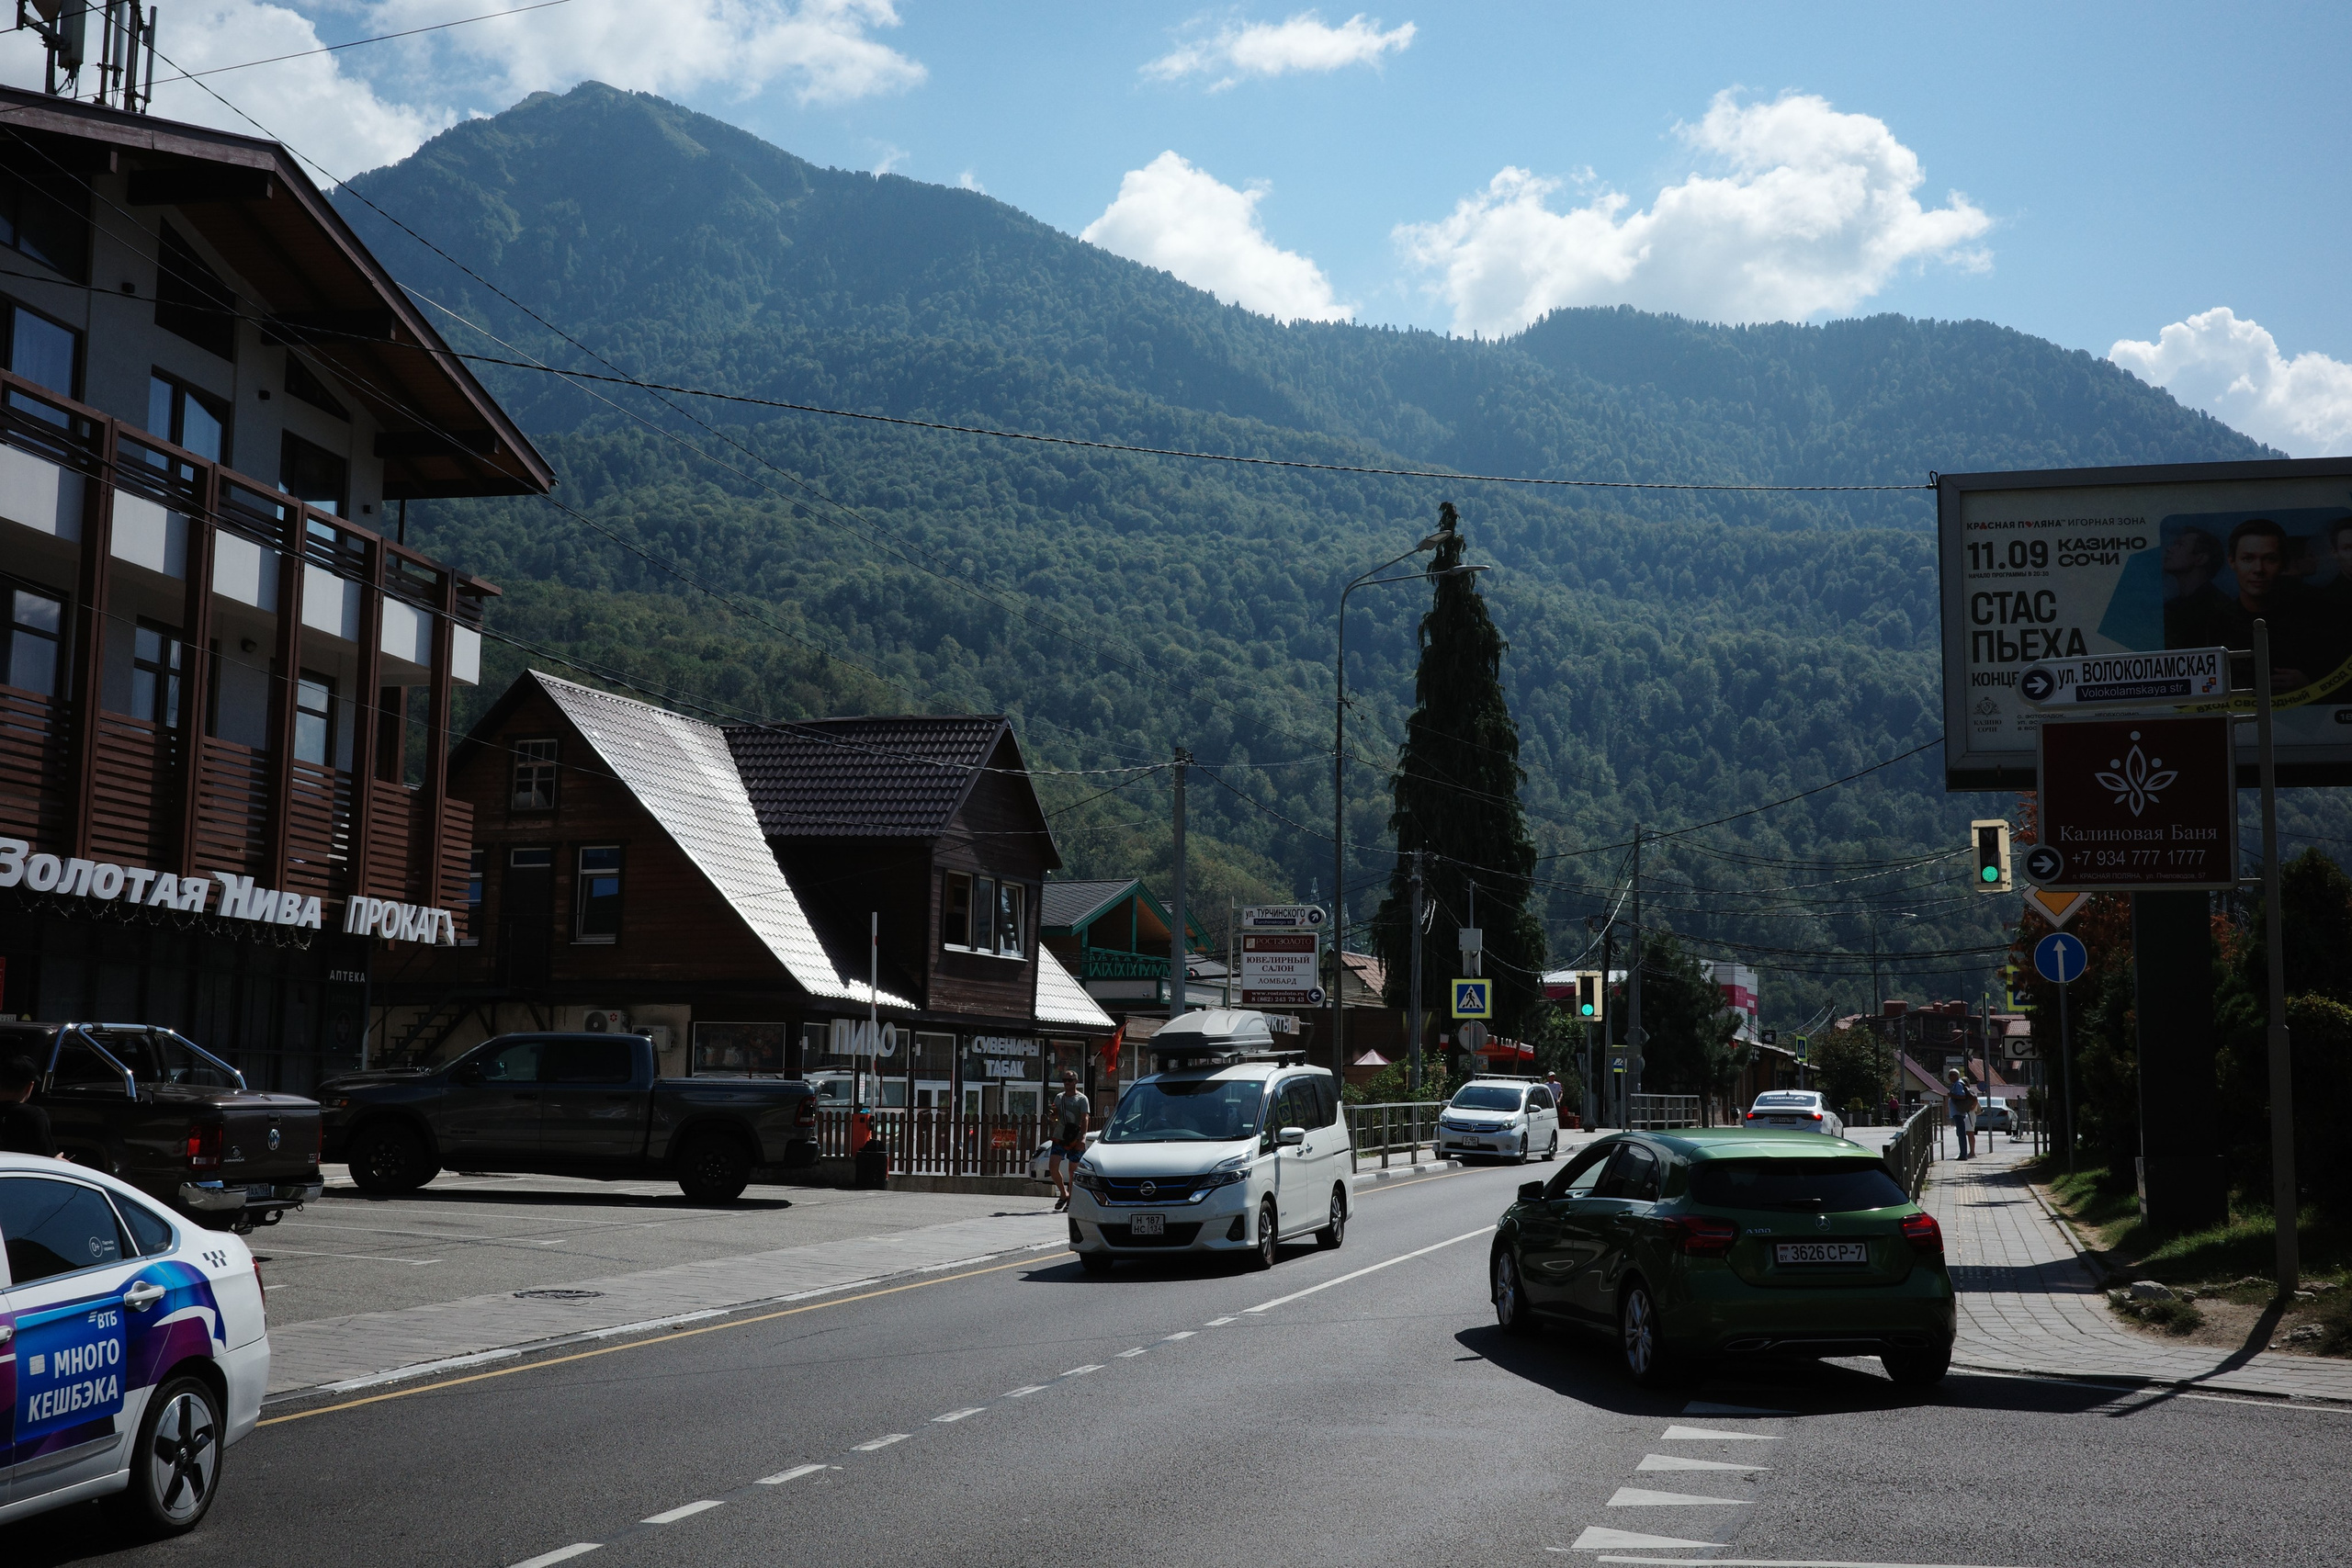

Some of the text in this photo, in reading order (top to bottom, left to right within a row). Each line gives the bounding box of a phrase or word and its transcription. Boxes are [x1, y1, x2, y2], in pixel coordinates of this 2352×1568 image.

[2068, 517, 2115, 527] ИГОРНАЯ
[2118, 516, 2146, 526] ЗОНА
[2058, 536, 2147, 552] КАЗИНО
[1967, 540, 2049, 570] 11.09
[2058, 553, 2120, 568] СОЧИ
[1992, 570, 2027, 579] ПРОГРАММЫ
[1971, 590, 2057, 626] СТАС
[1972, 627, 2089, 663] ПЬЕХА
[1972, 671, 2020, 688] КОНЦЕ
[2057, 654, 2217, 690] ул. ВОЛОКОЛАМСКАЯ
[2320, 670, 2349, 692] ВХОД
[2081, 683, 2188, 699] Volokolamskaya str.
[2233, 690, 2312, 708] СВООДНЫЙ
[2059, 824, 2218, 842] Калиновая Баня
[2072, 849, 2206, 866] +7 934 777 1777
[343, 895, 445, 945] ПРОКАТ
[1245, 908, 1306, 919] ул. ТУРЧИНСКОГО
[1246, 955, 1310, 964] ЮВЕЛИРНЫЙ
[329, 969, 366, 983] АПТЕКА
[1265, 1015, 1292, 1033] УКТЫ
[830, 1019, 897, 1057] ПИВО
[971, 1035, 1040, 1056] СУВЕНИРЫ
[984, 1059, 1025, 1078] ТАБАК
[1791, 1246, 1825, 1260] 3626
[97, 1310, 118, 1329] ВТБ
[53, 1337, 120, 1379] МНОГО
[28, 1374, 119, 1424] КЕШБЭКА
